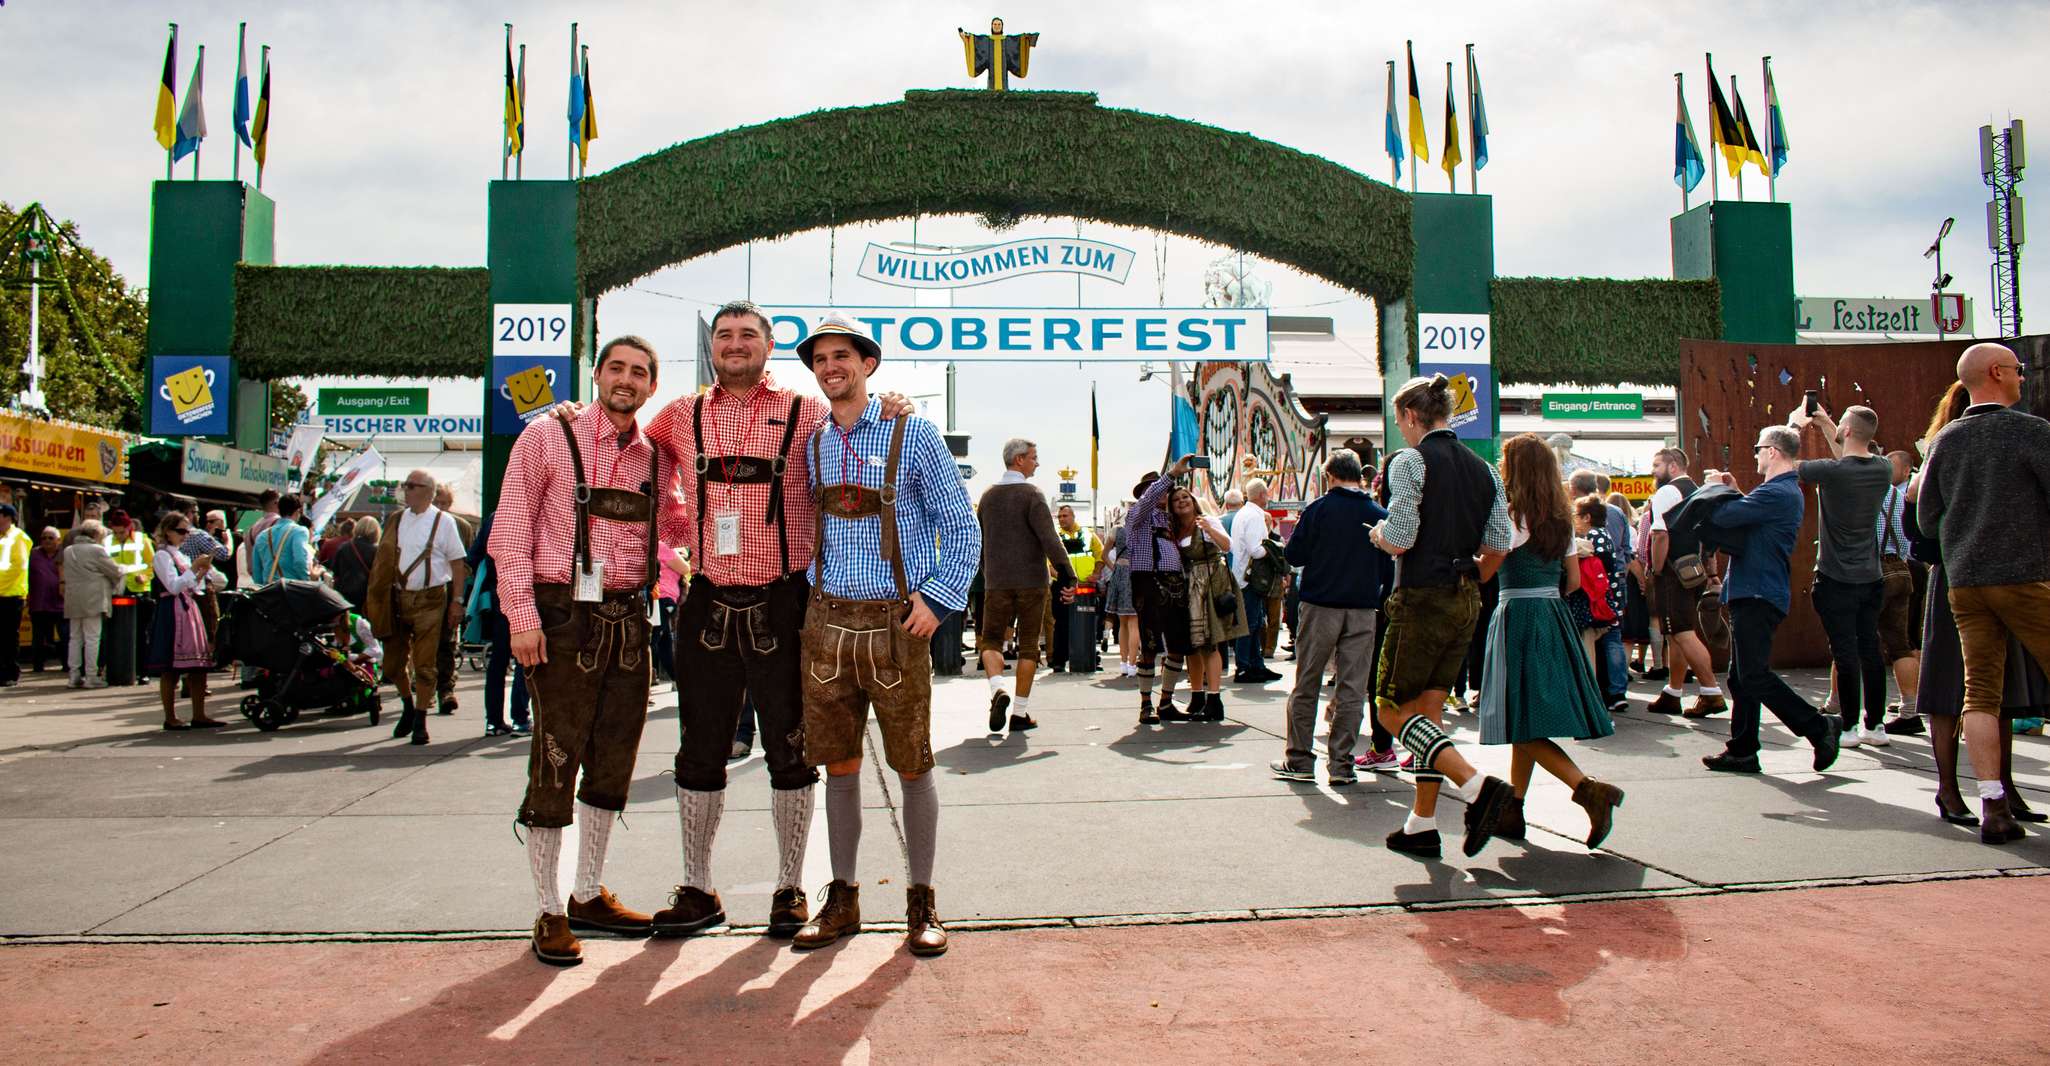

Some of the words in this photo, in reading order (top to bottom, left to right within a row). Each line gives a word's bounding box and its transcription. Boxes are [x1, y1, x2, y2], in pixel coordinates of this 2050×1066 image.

[876, 245, 1049, 282] WILLKOMMEN
[1060, 245, 1116, 272] ZUM
[499, 317, 566, 342] 2019
[771, 315, 1247, 352] OTOBERFEST
[1424, 326, 1486, 350] 2019
[336, 396, 411, 407] Ausgang/Exit
[1548, 401, 1637, 412] Eingang/Entrance
[324, 418, 406, 433] FISCHER
[413, 418, 481, 433] VRONI
[187, 448, 230, 477] Souvenir
